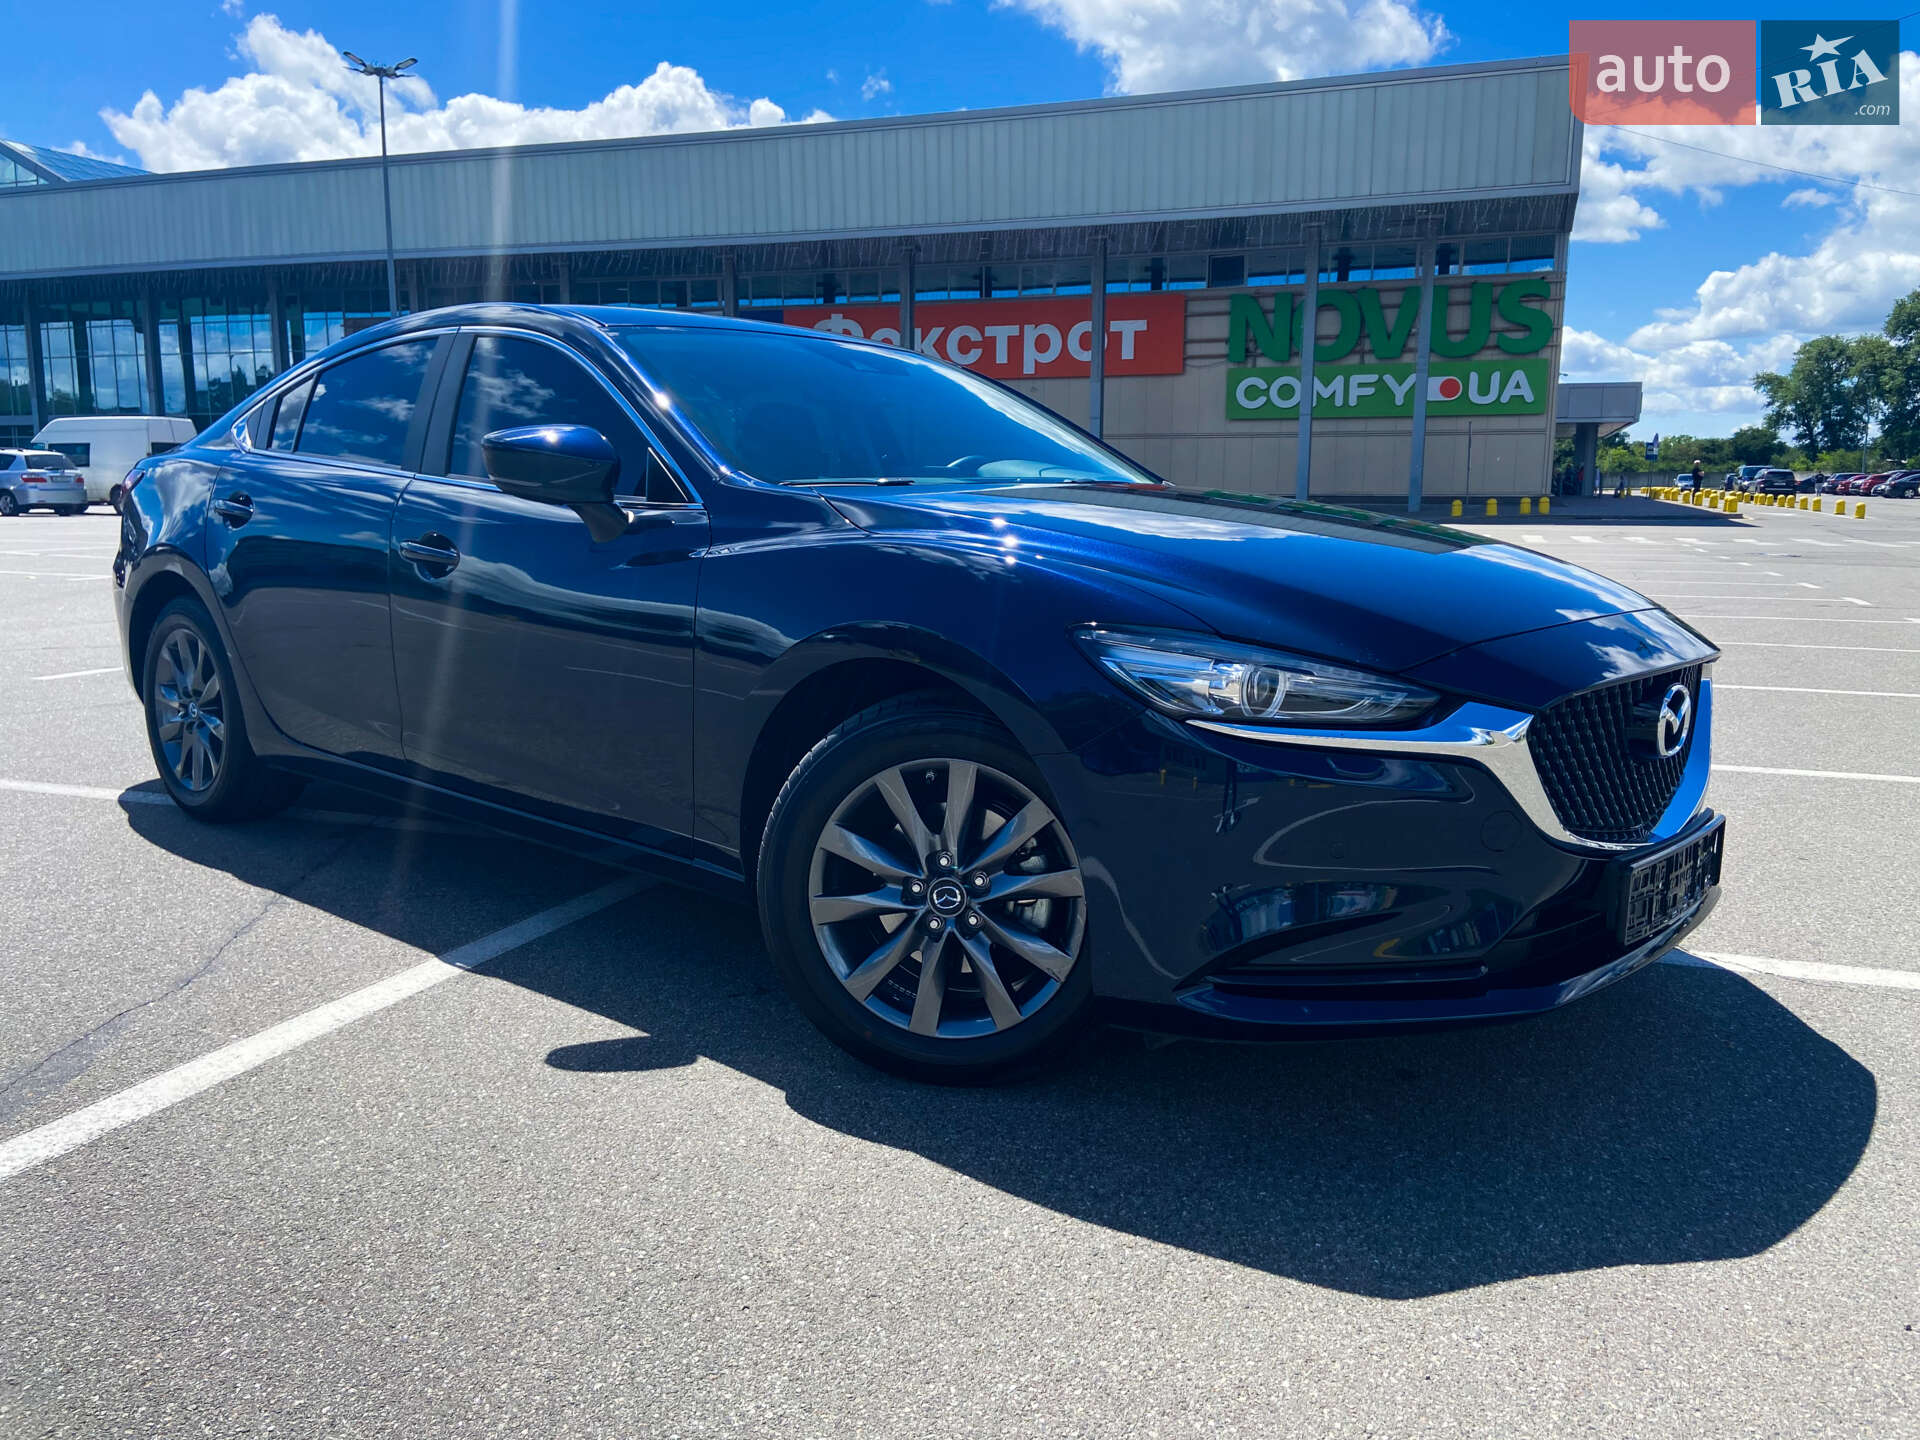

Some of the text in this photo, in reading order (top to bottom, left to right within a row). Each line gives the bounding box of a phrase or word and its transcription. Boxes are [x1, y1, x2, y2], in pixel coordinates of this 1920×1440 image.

[1227, 279, 1554, 363] NOVUS
[1236, 369, 1535, 409] COMFY UA
